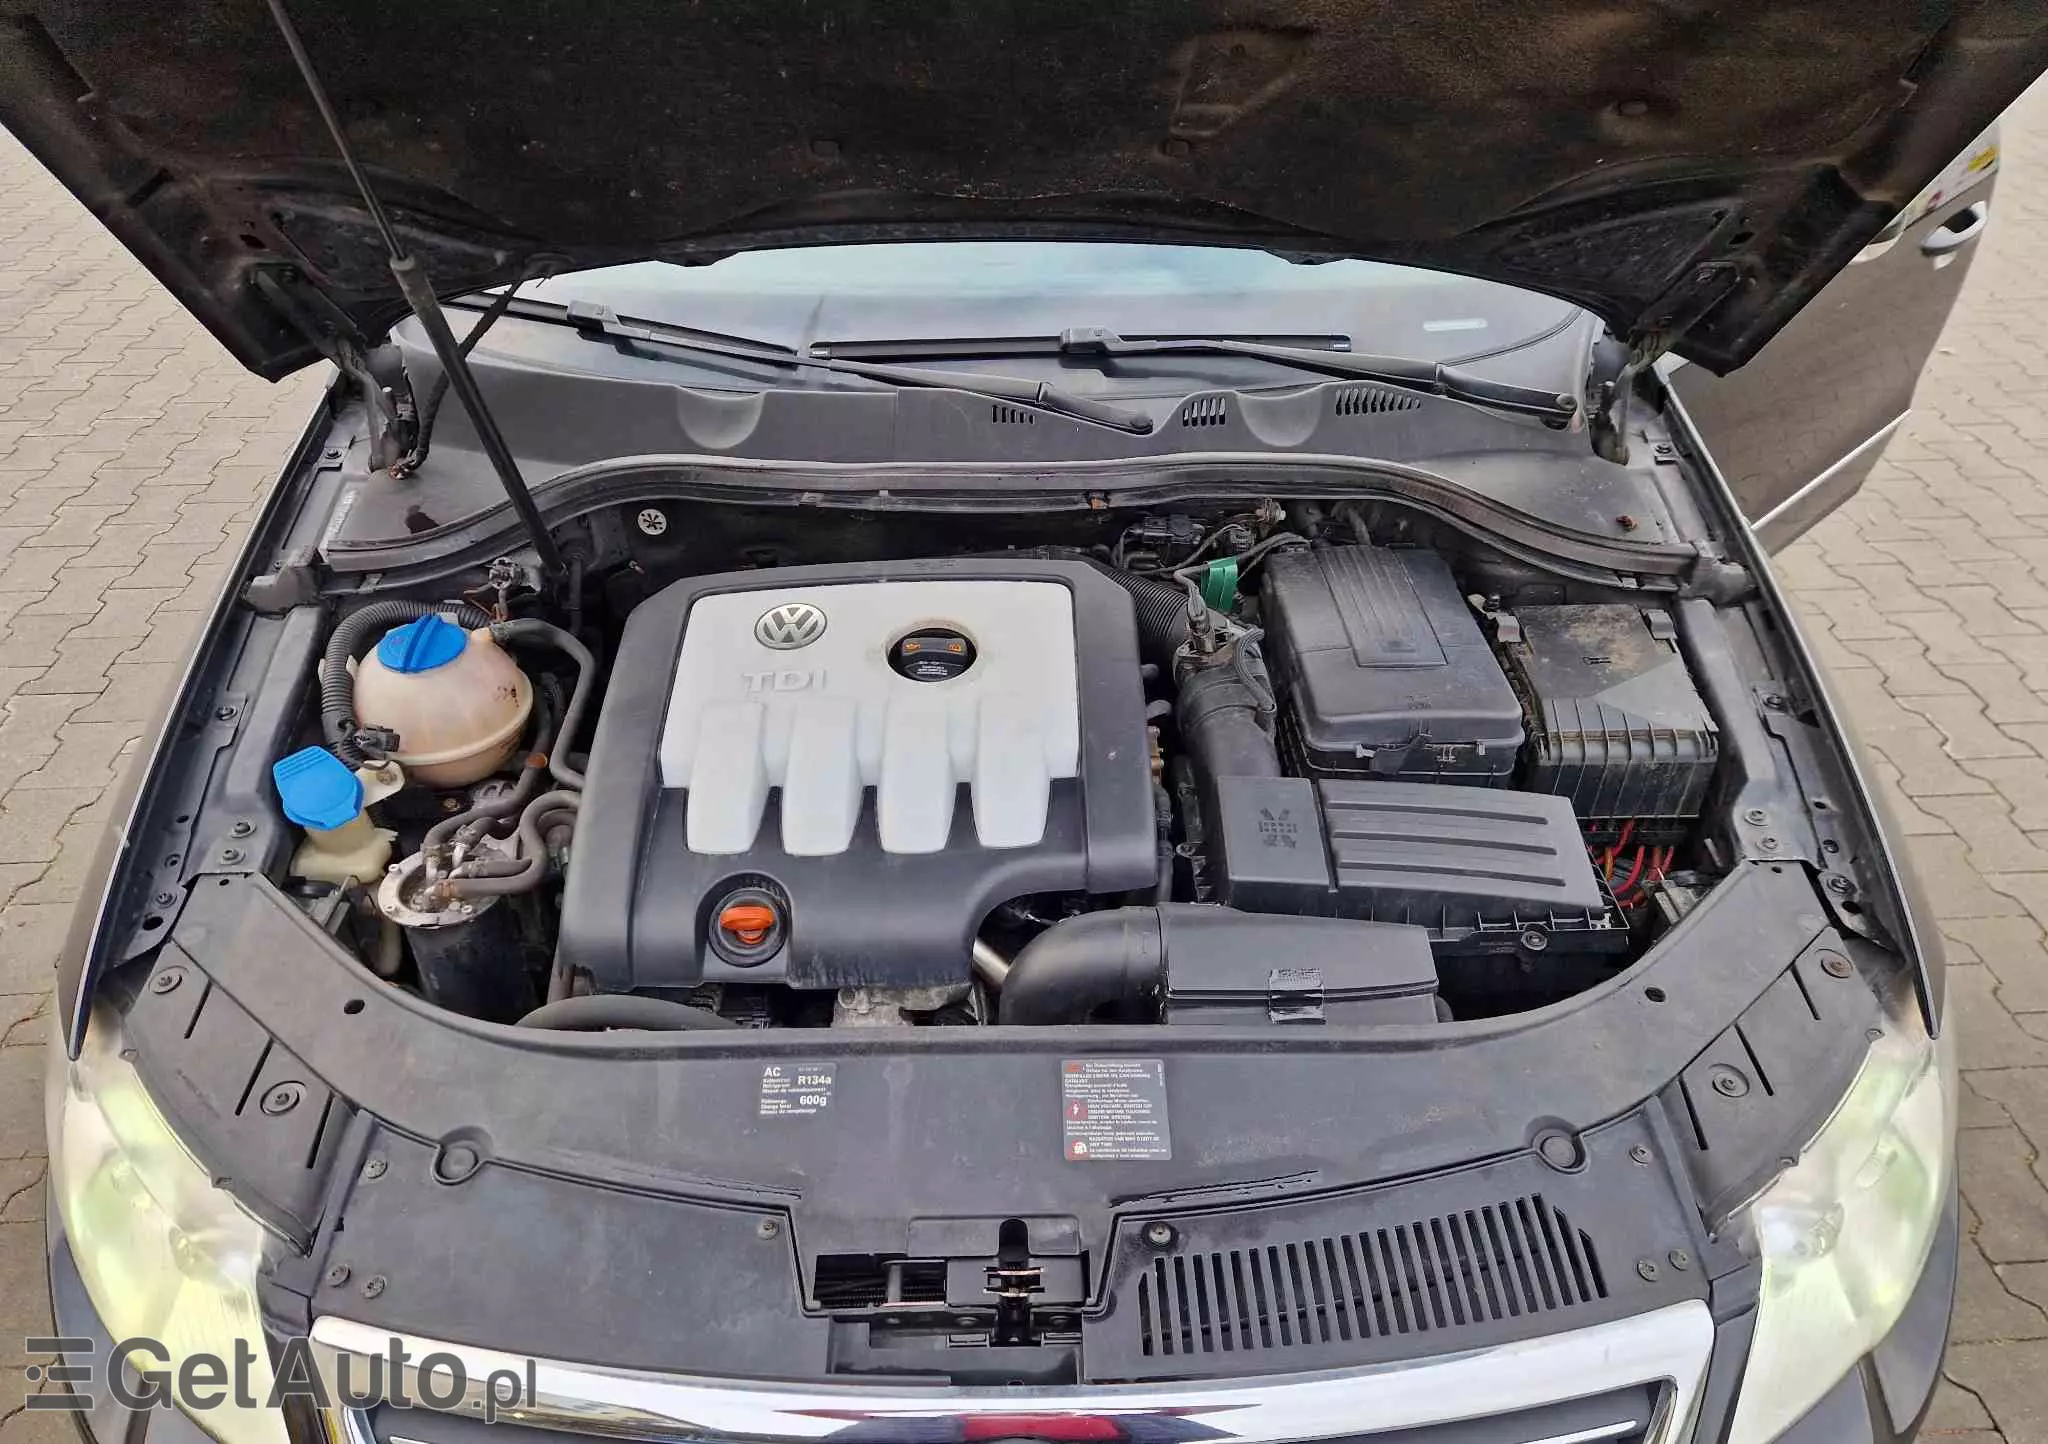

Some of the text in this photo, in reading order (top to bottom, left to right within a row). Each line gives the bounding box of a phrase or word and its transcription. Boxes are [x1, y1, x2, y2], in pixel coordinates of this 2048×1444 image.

[742, 669, 828, 694] TDI
[763, 1066, 781, 1077] AC
[798, 1075, 832, 1086] R134a
[799, 1095, 827, 1107] 600g
